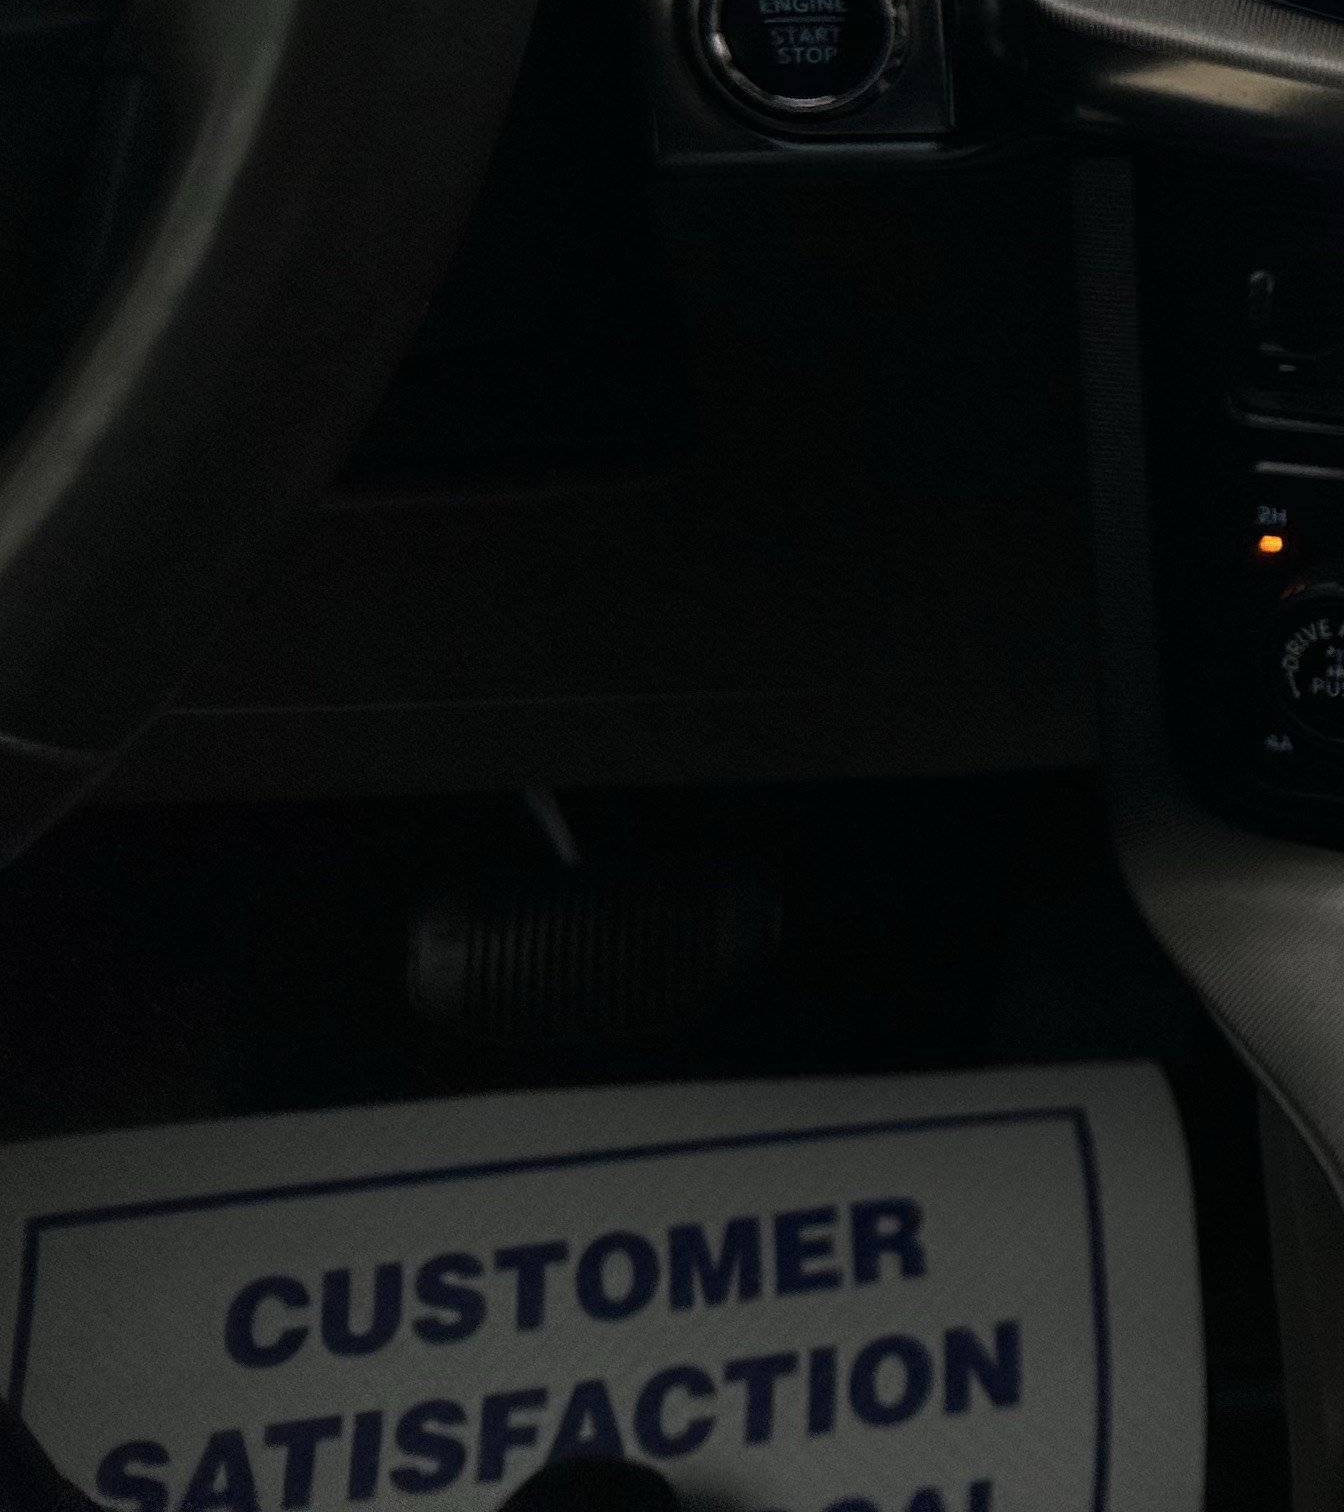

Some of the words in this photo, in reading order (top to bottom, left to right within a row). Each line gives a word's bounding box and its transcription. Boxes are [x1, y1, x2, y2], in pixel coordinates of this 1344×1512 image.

[769, 25, 840, 46] START
[776, 46, 839, 65] STOP
[1257, 504, 1288, 526] 2H
[1281, 617, 1333, 672] DRIVE
[222, 1194, 931, 1371] CUSTOMER
[95, 1319, 1023, 1512] SATISFACTION
